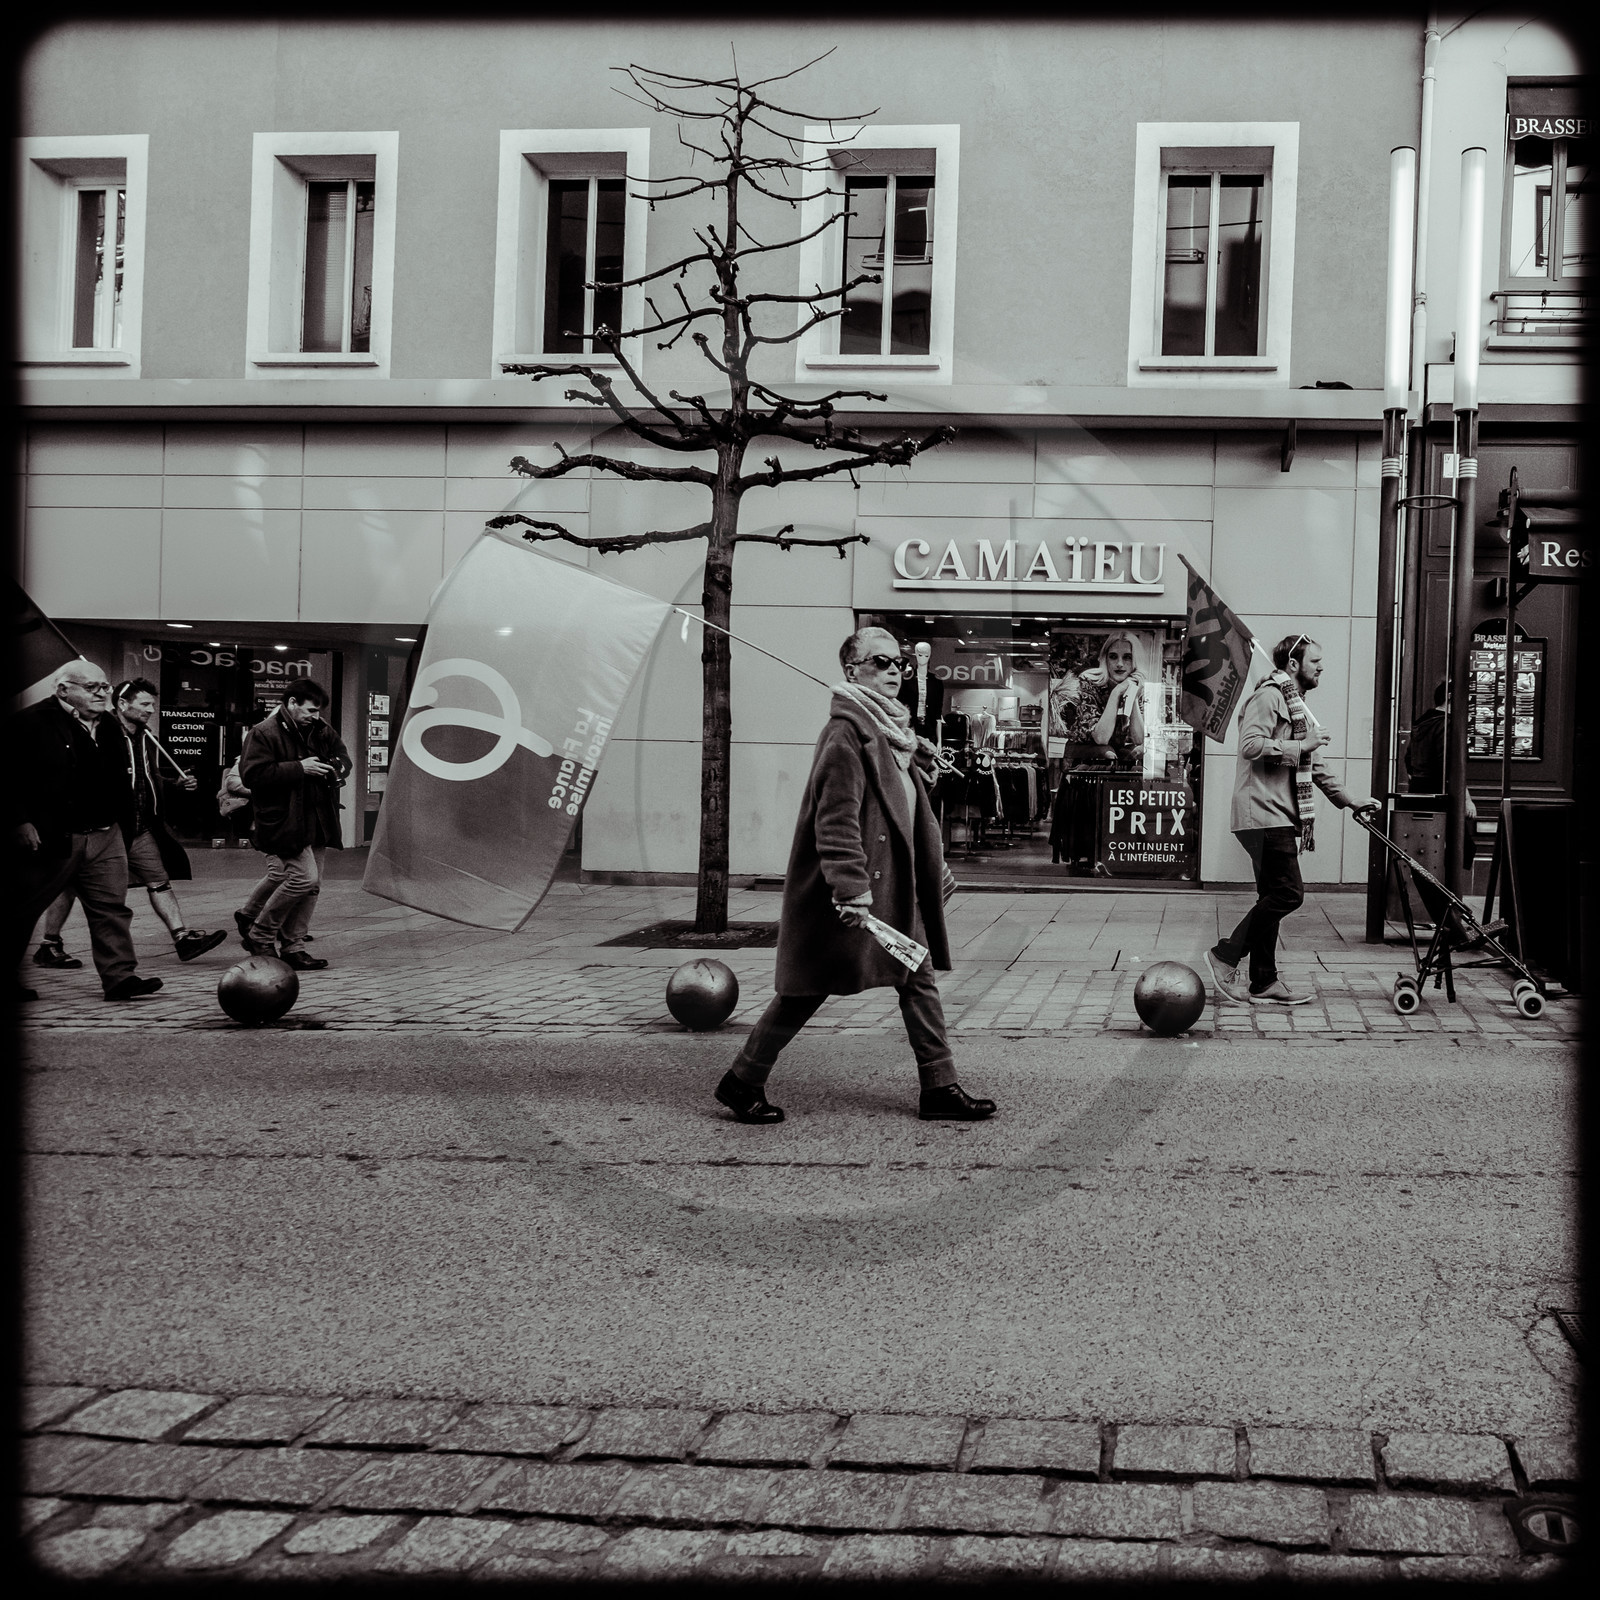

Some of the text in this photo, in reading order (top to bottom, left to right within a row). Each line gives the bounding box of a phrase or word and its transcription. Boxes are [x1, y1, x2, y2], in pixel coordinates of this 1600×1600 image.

[1473, 633, 1523, 643] BRASSEIE
[161, 710, 215, 719] TRANSACTION
[171, 723, 205, 731] GESTION
[168, 735, 207, 743] LOCATION
[1109, 789, 1186, 807] LES PETITS
[1108, 806, 1186, 836] PRIX
[1108, 841, 1185, 852] CONTINUENT
[1108, 850, 1116, 861] À
